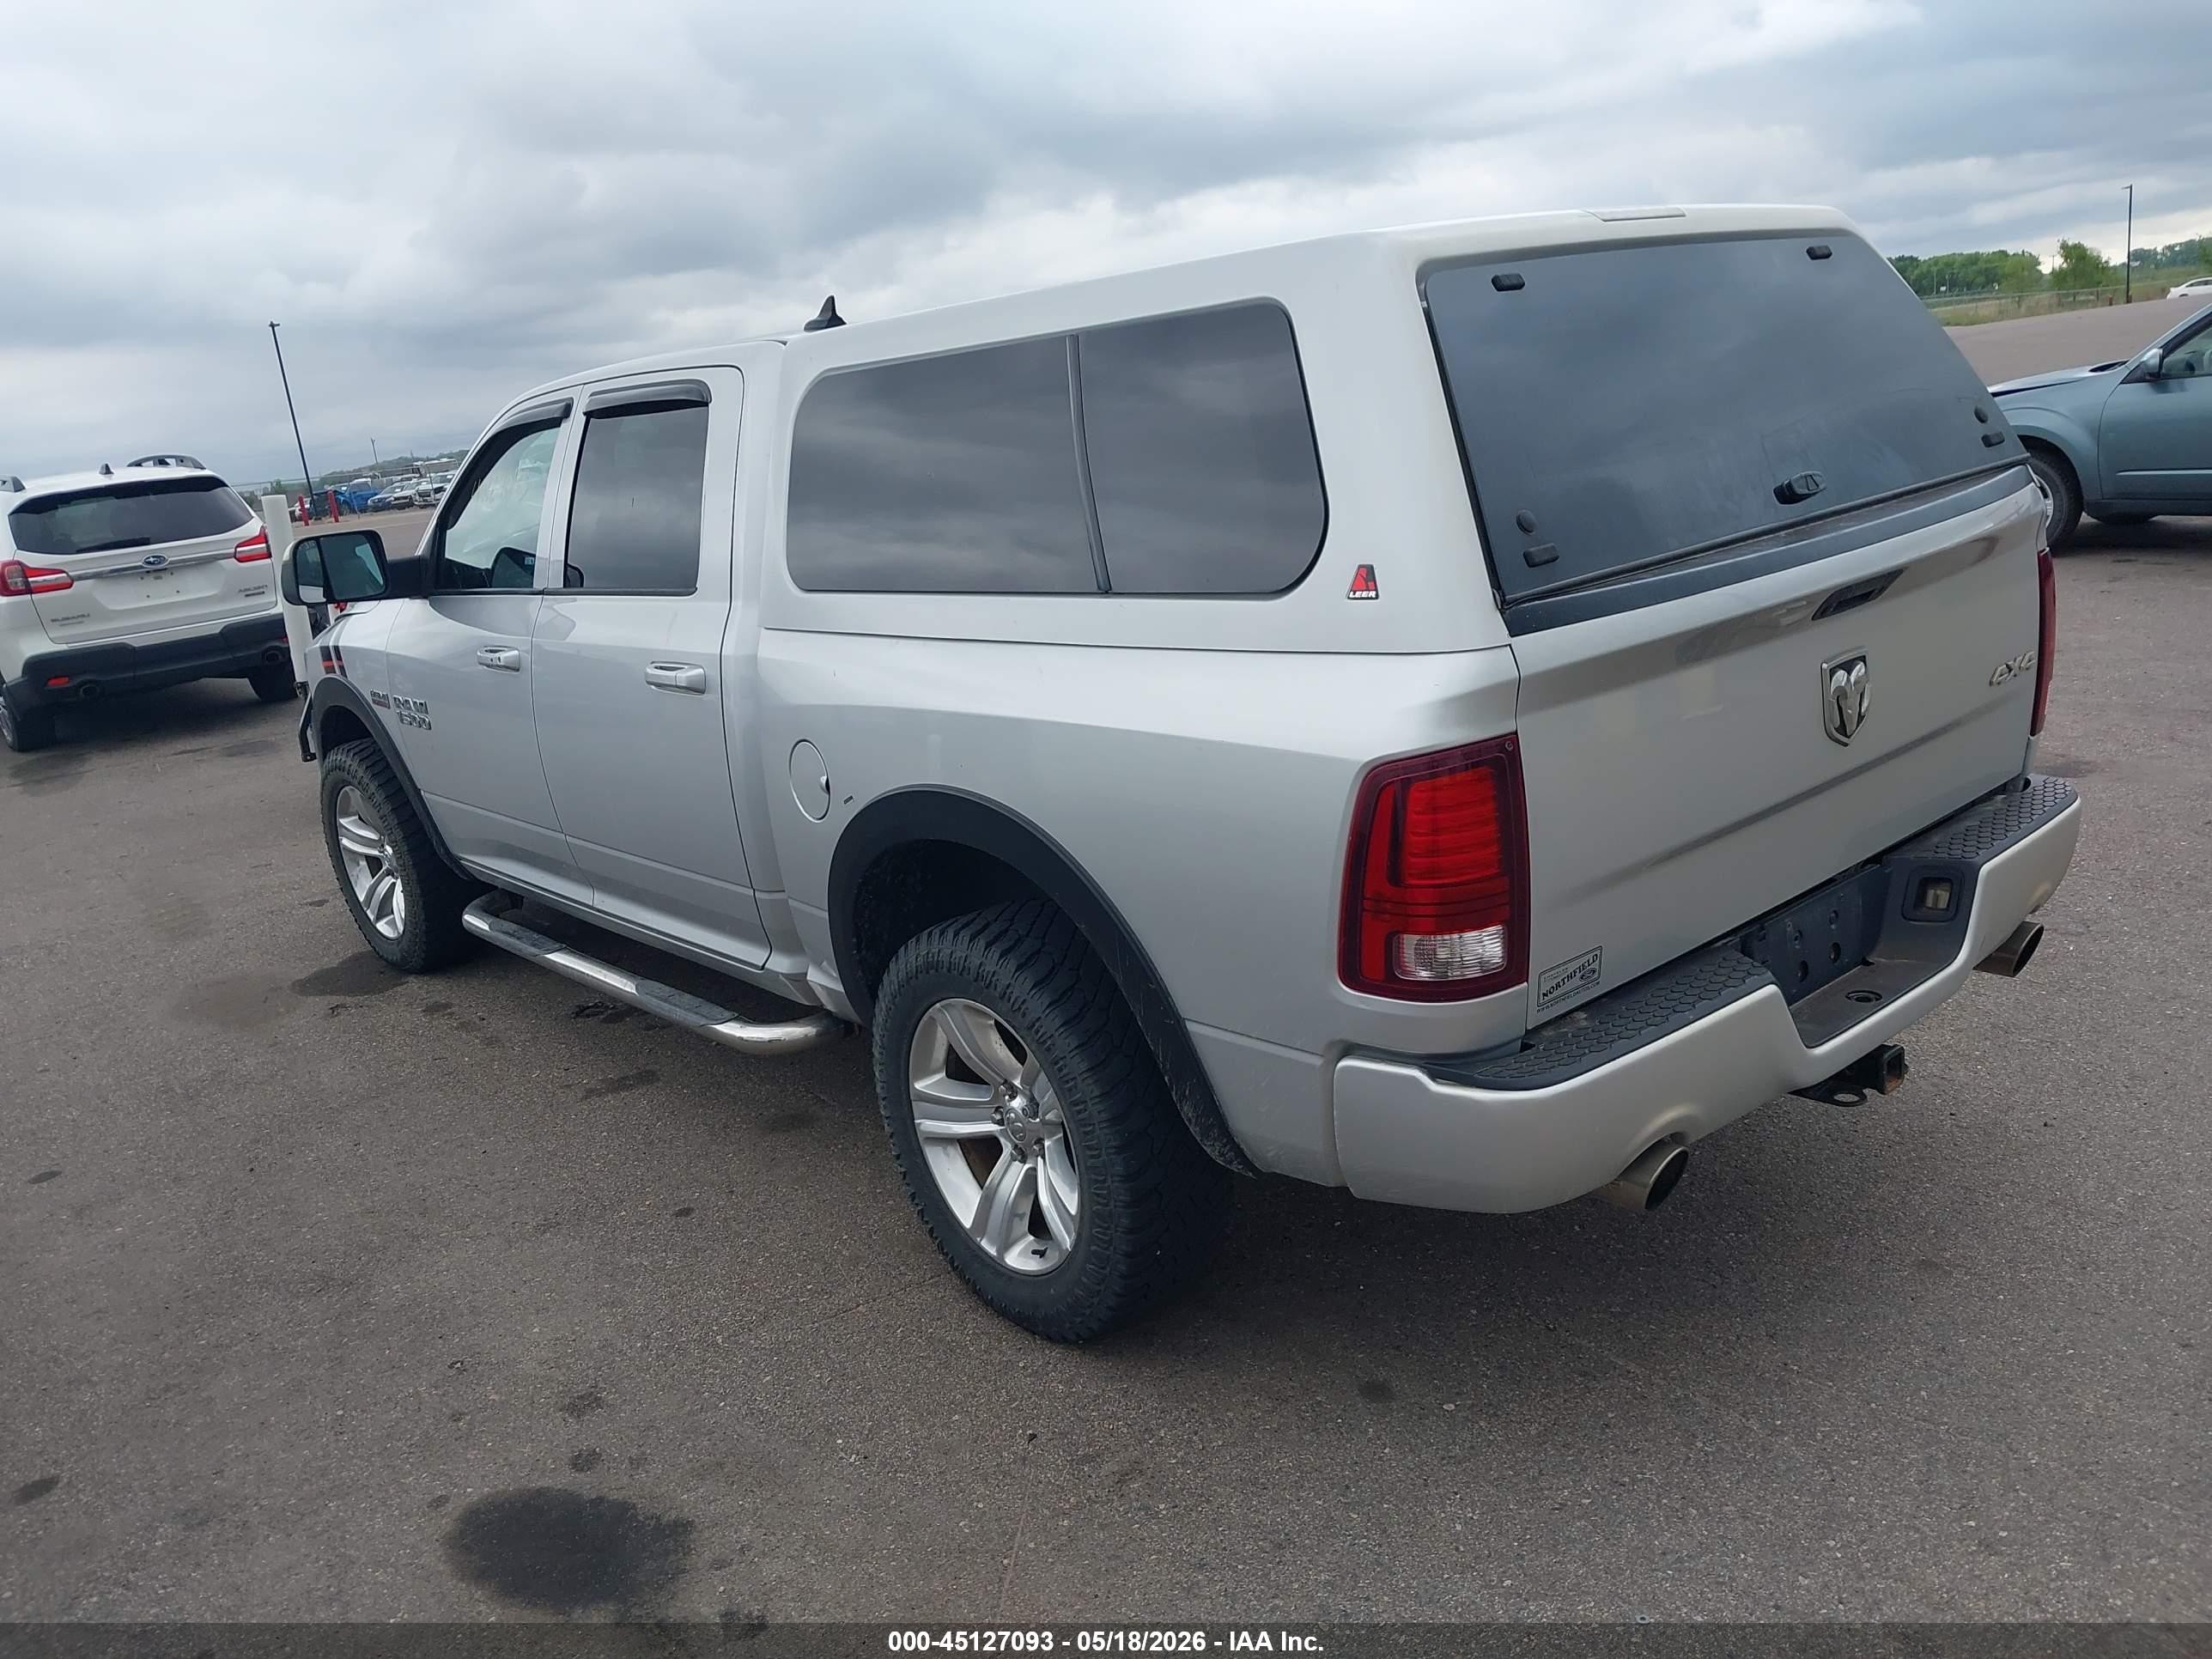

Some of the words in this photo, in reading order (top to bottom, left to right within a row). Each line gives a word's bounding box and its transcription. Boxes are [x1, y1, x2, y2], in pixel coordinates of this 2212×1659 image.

[1349, 590, 1377, 599] LEER
[392, 695, 428, 714] RAM
[1541, 953, 1598, 1000] NORTHFIELD
